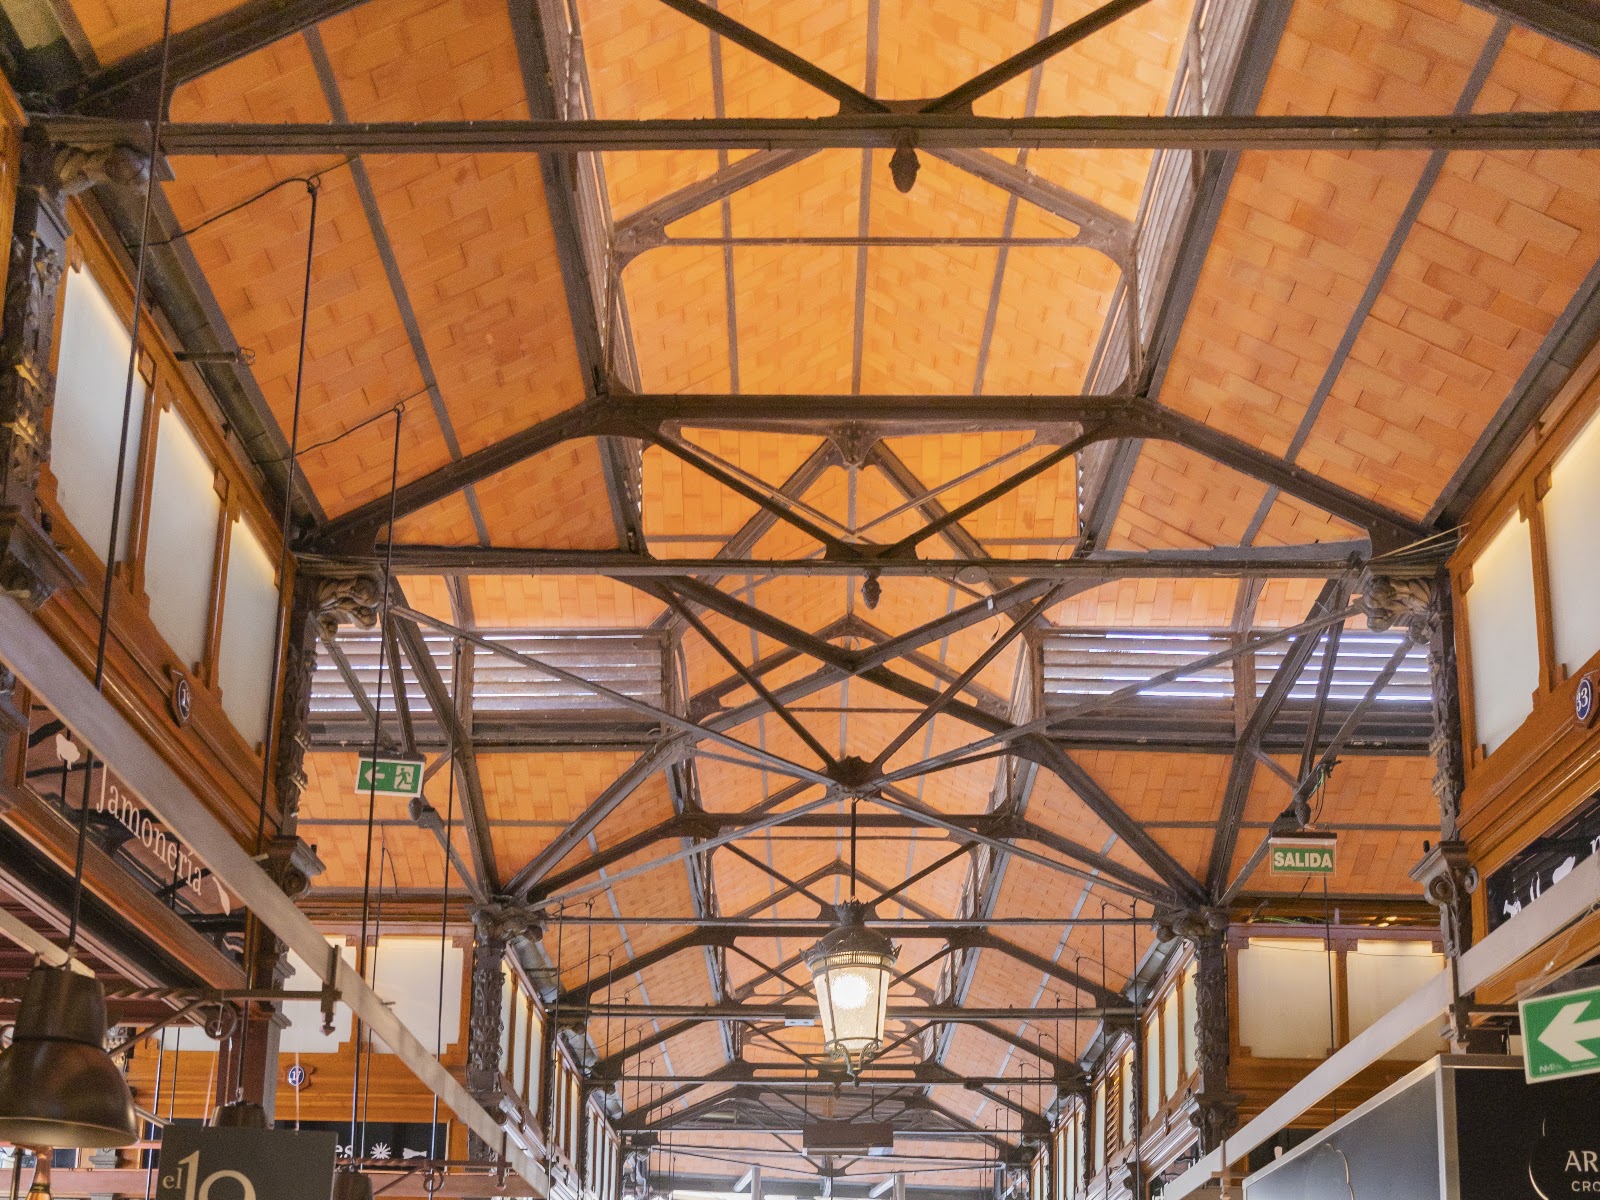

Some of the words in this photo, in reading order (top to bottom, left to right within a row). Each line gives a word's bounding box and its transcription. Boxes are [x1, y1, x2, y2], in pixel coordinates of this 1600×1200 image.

[96, 764, 202, 896] Jamonería
[1274, 851, 1332, 868] SALIDA
[162, 1167, 182, 1190] el
